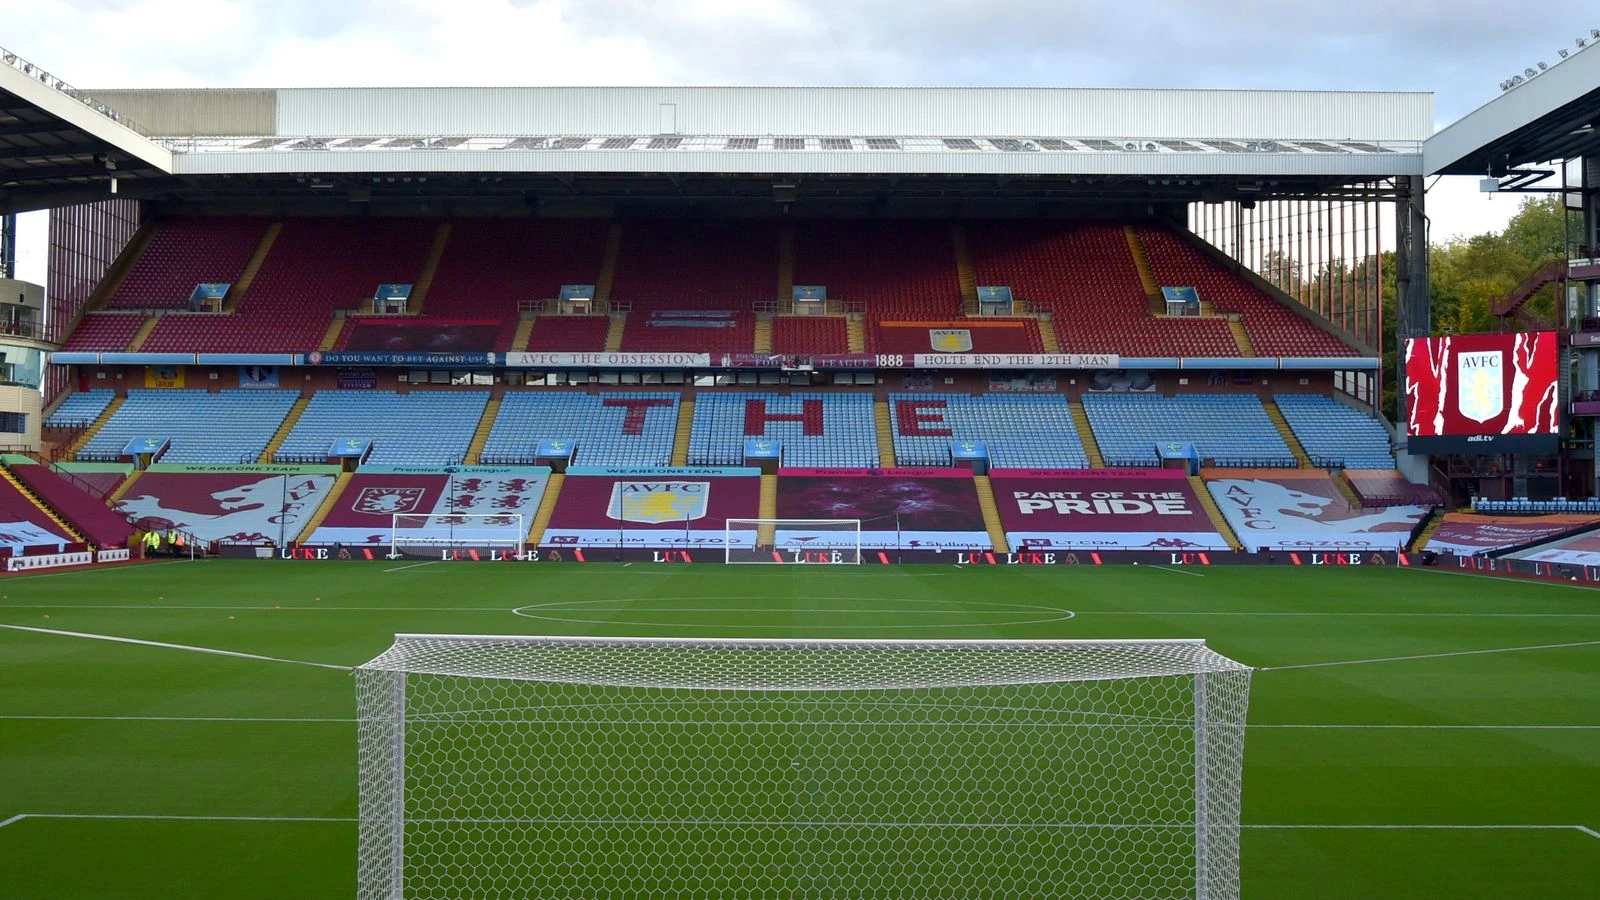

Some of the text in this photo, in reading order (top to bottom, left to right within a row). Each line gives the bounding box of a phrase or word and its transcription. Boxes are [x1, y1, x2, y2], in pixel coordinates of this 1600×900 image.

[520, 354, 696, 364] AVFC THE OBSESSION
[875, 354, 904, 367] 1888
[924, 355, 1110, 366] HOLTE END THE 12TH MAN
[1463, 355, 1498, 368] AVFC
[367, 488, 421, 496] AVFC
[623, 483, 701, 493] AVFC
[1013, 491, 1185, 500] PART OF THE
[1017, 499, 1193, 515] PRIDE
[281, 548, 328, 560] LUKE
[490, 549, 539, 561] LUE
[794, 551, 843, 564] LUKE
[1007, 552, 1056, 565] LUKE
[1311, 553, 1361, 565] LUKE
